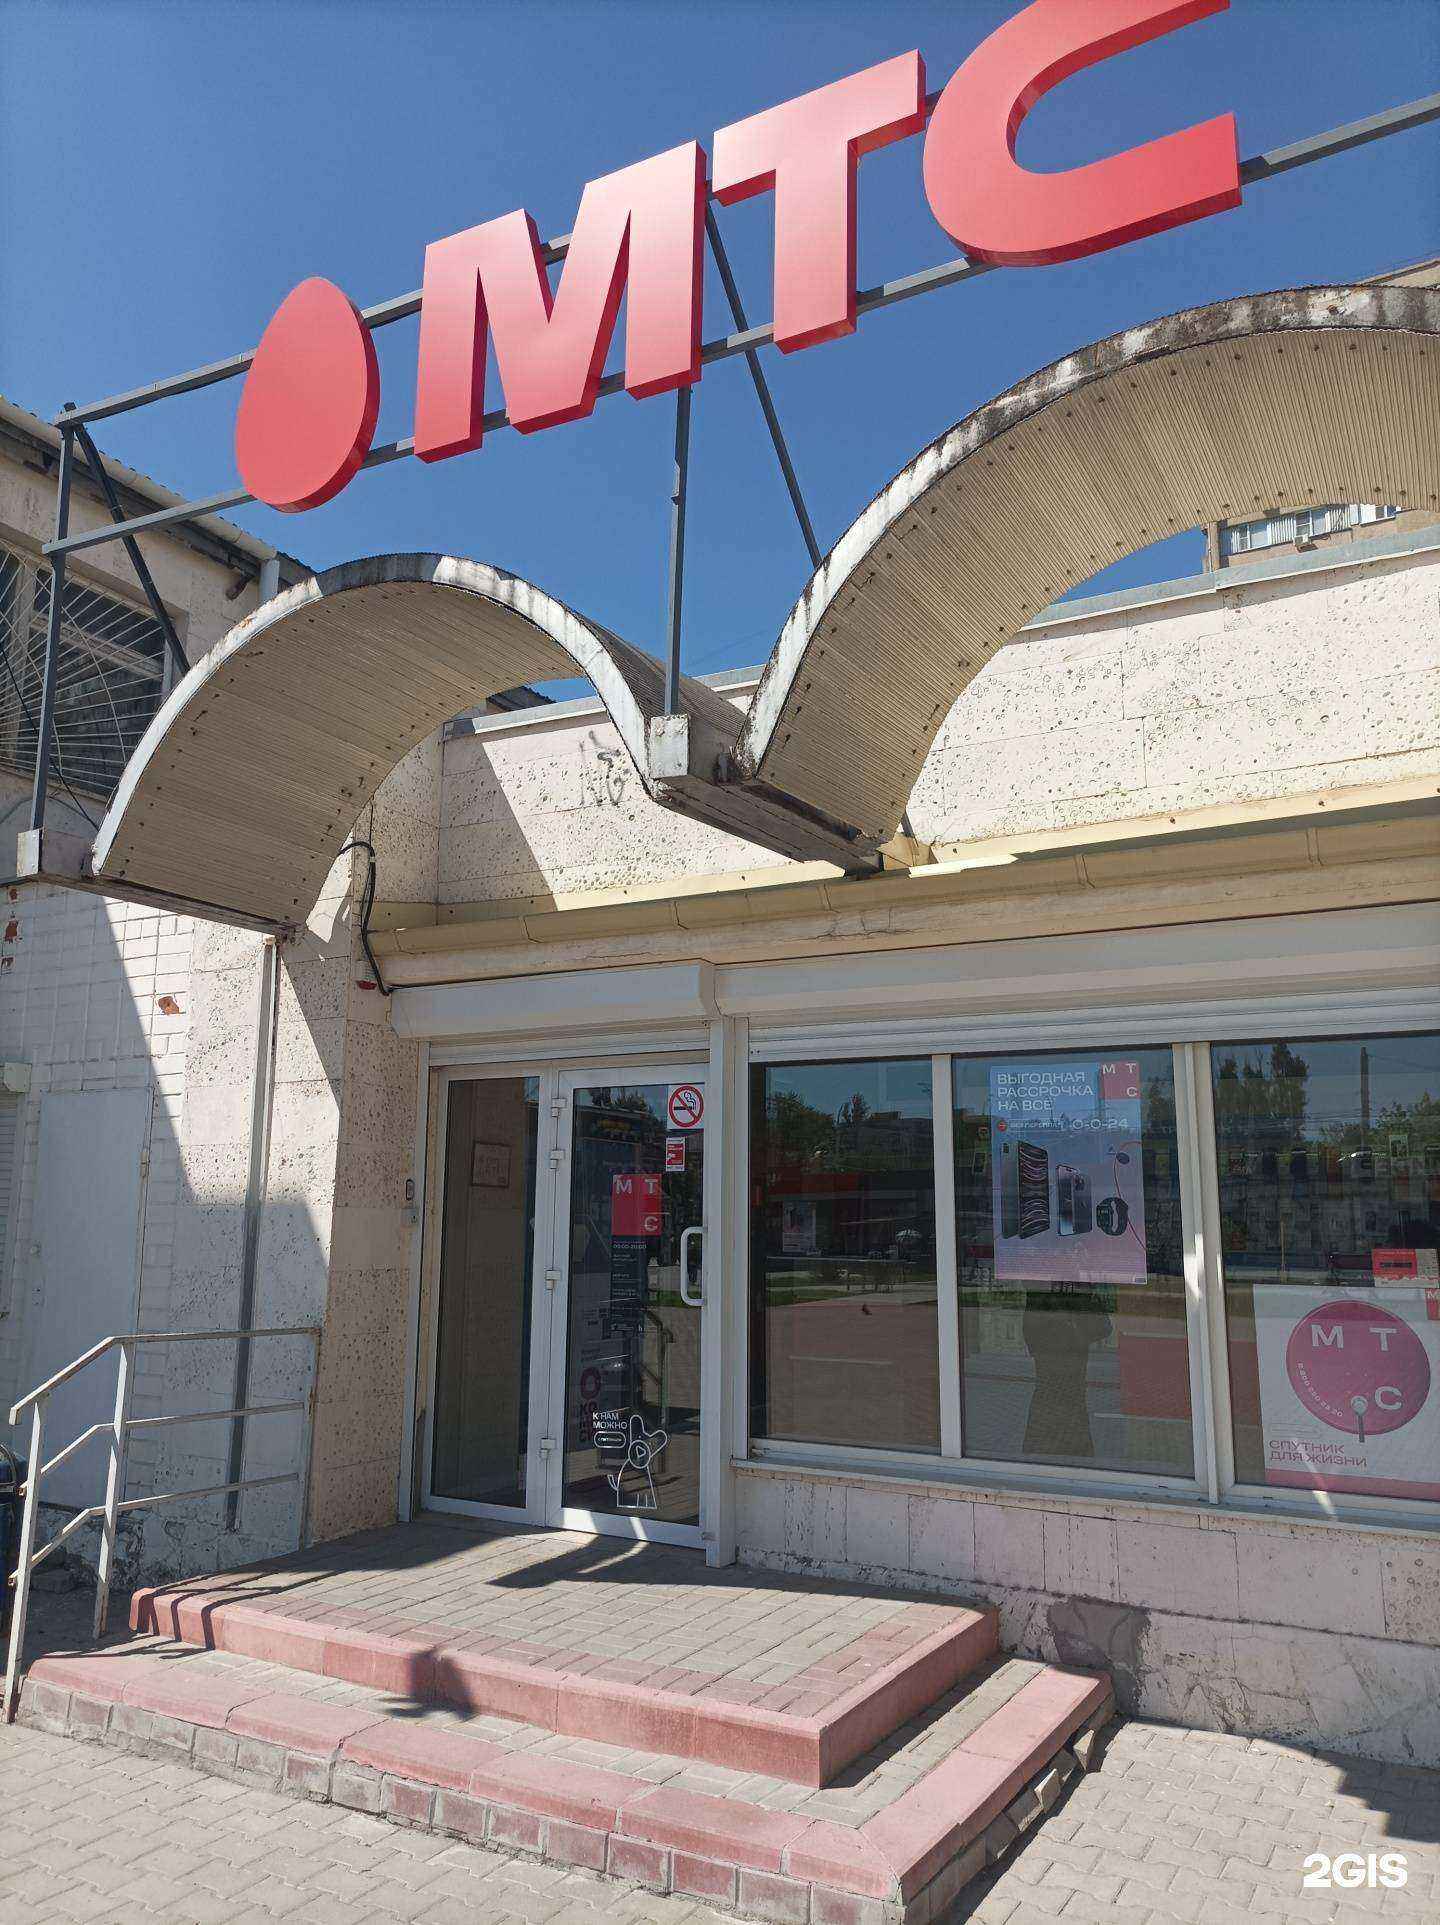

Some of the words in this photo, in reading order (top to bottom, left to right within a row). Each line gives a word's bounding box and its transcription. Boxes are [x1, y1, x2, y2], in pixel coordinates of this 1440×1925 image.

[414, 0, 1241, 463] МТС
[997, 1071, 1085, 1085] ВЫГОДНАЯ
[997, 1085, 1095, 1098] РАССРОЧКА
[998, 1100, 1019, 1111] НА
[1311, 1324, 1344, 1348] М
[1369, 1327, 1397, 1351] Т
[592, 1411, 599, 1421] К
[601, 1412, 619, 1421] НАМ
[592, 1421, 628, 1430] МОЖНО
[1269, 1440, 1345, 1455] СПУТНИК
[1270, 1450, 1304, 1462] ДЛЯ
[1305, 1452, 1368, 1468] ЖИЗНИ
